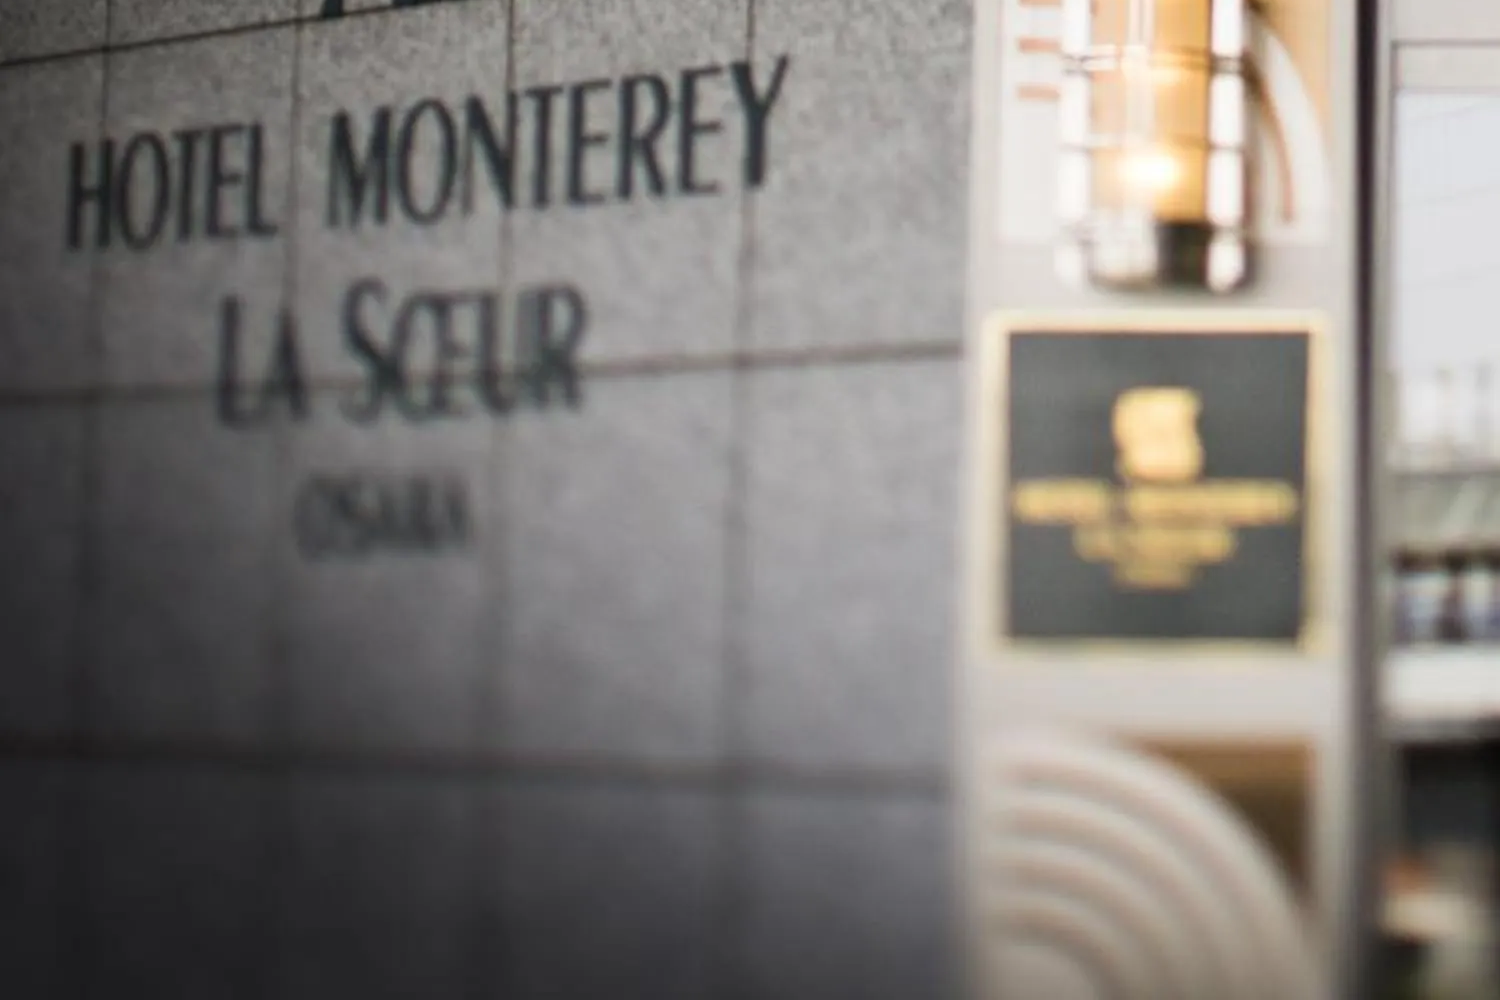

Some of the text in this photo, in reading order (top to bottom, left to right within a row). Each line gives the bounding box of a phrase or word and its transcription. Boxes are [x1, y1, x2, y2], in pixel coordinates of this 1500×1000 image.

[65, 54, 790, 252] HOTEL MONTEREY
[215, 293, 312, 430] LA
